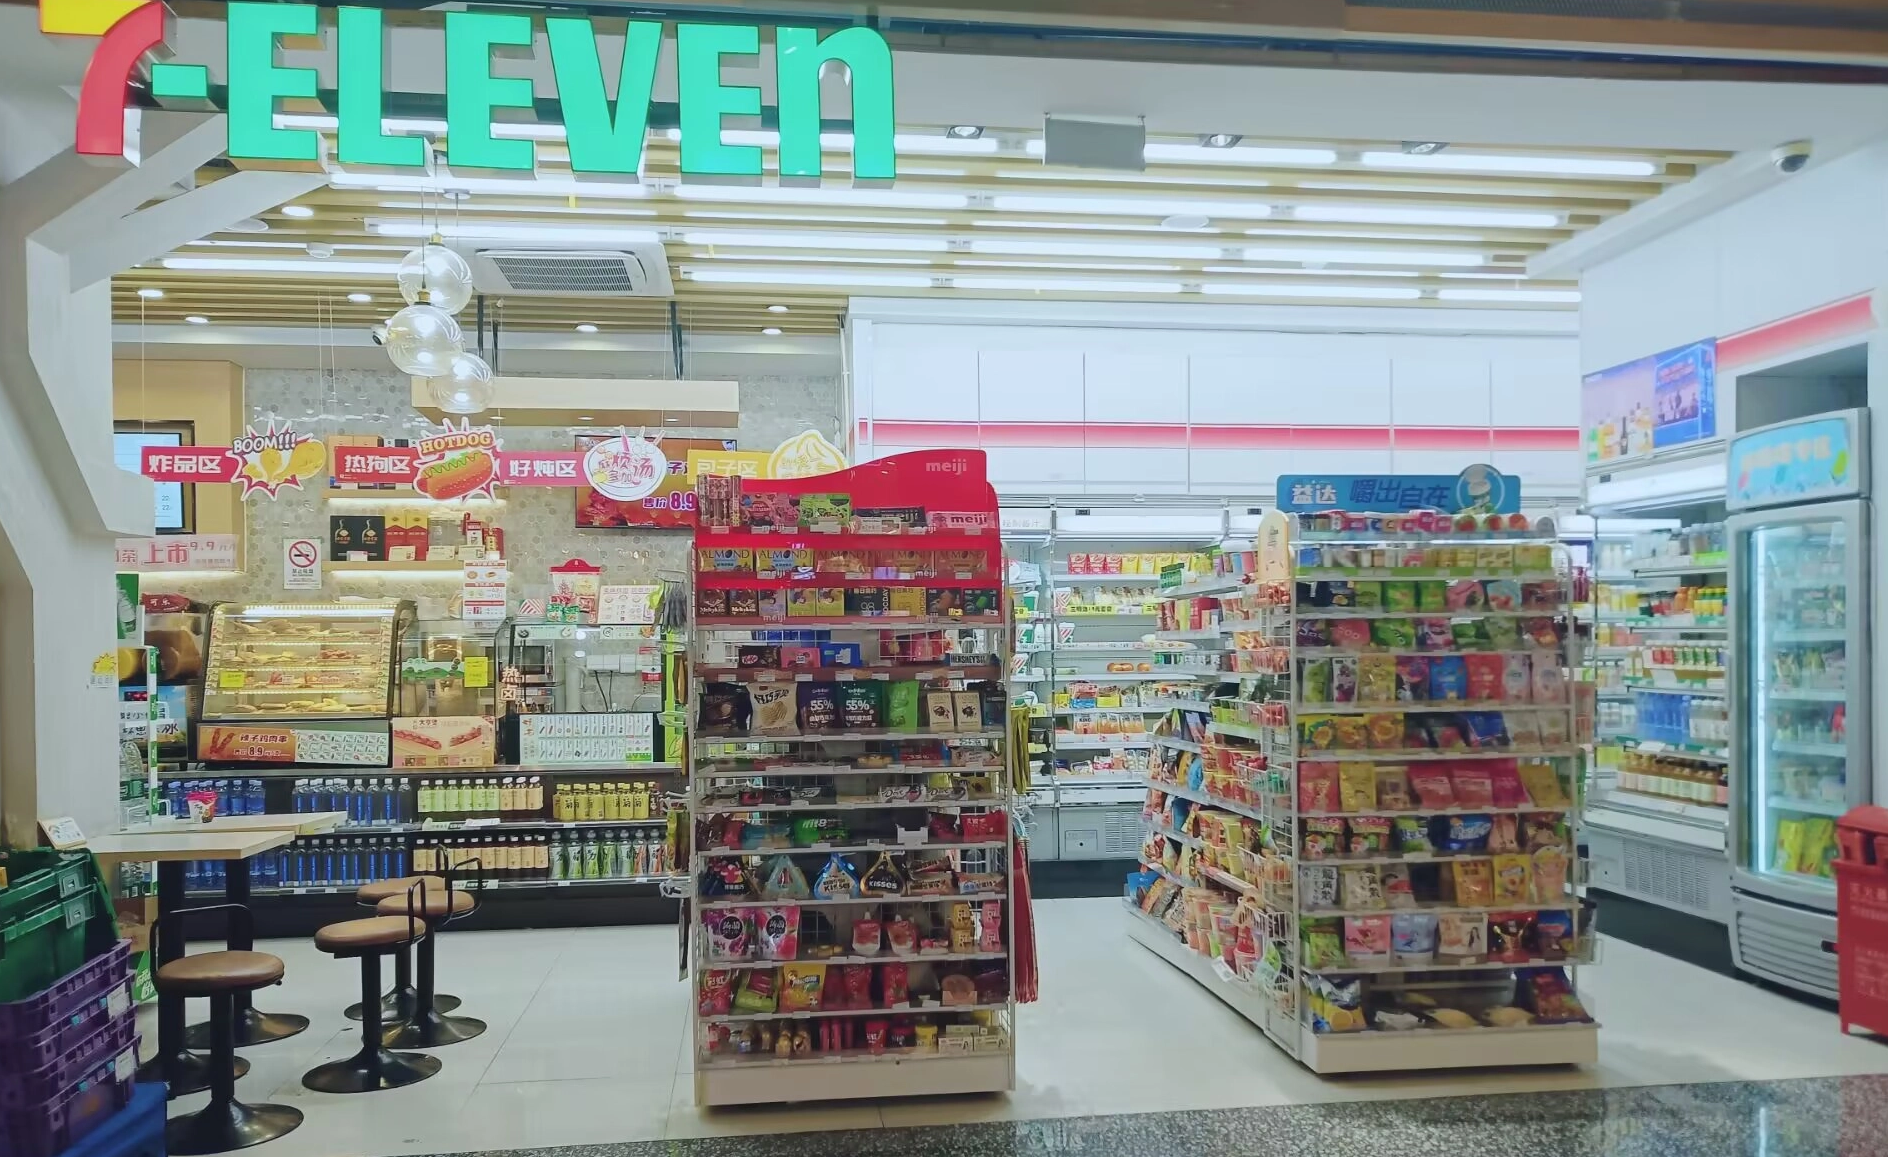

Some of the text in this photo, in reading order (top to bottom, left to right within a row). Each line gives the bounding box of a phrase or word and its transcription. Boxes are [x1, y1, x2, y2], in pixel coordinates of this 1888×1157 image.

[233, 433, 297, 454] BOOM!!!
[420, 433, 492, 454] HOTDOG
[148, 455, 222, 474] 炸品区
[344, 455, 411, 474] 热狗区
[509, 459, 578, 478] 好炖区
[926, 458, 968, 475] meiji
[670, 491, 698, 511] 8.9
[1291, 479, 1451, 509] 益达 嚼出自在
[950, 513, 988, 524] meiji
[141, 541, 190, 565] 上市
[190, 541, 215, 551] 9.9
[758, 550, 808, 559] ALMOND
[810, 699, 834, 711] 55%
[845, 699, 870, 711] 55%
